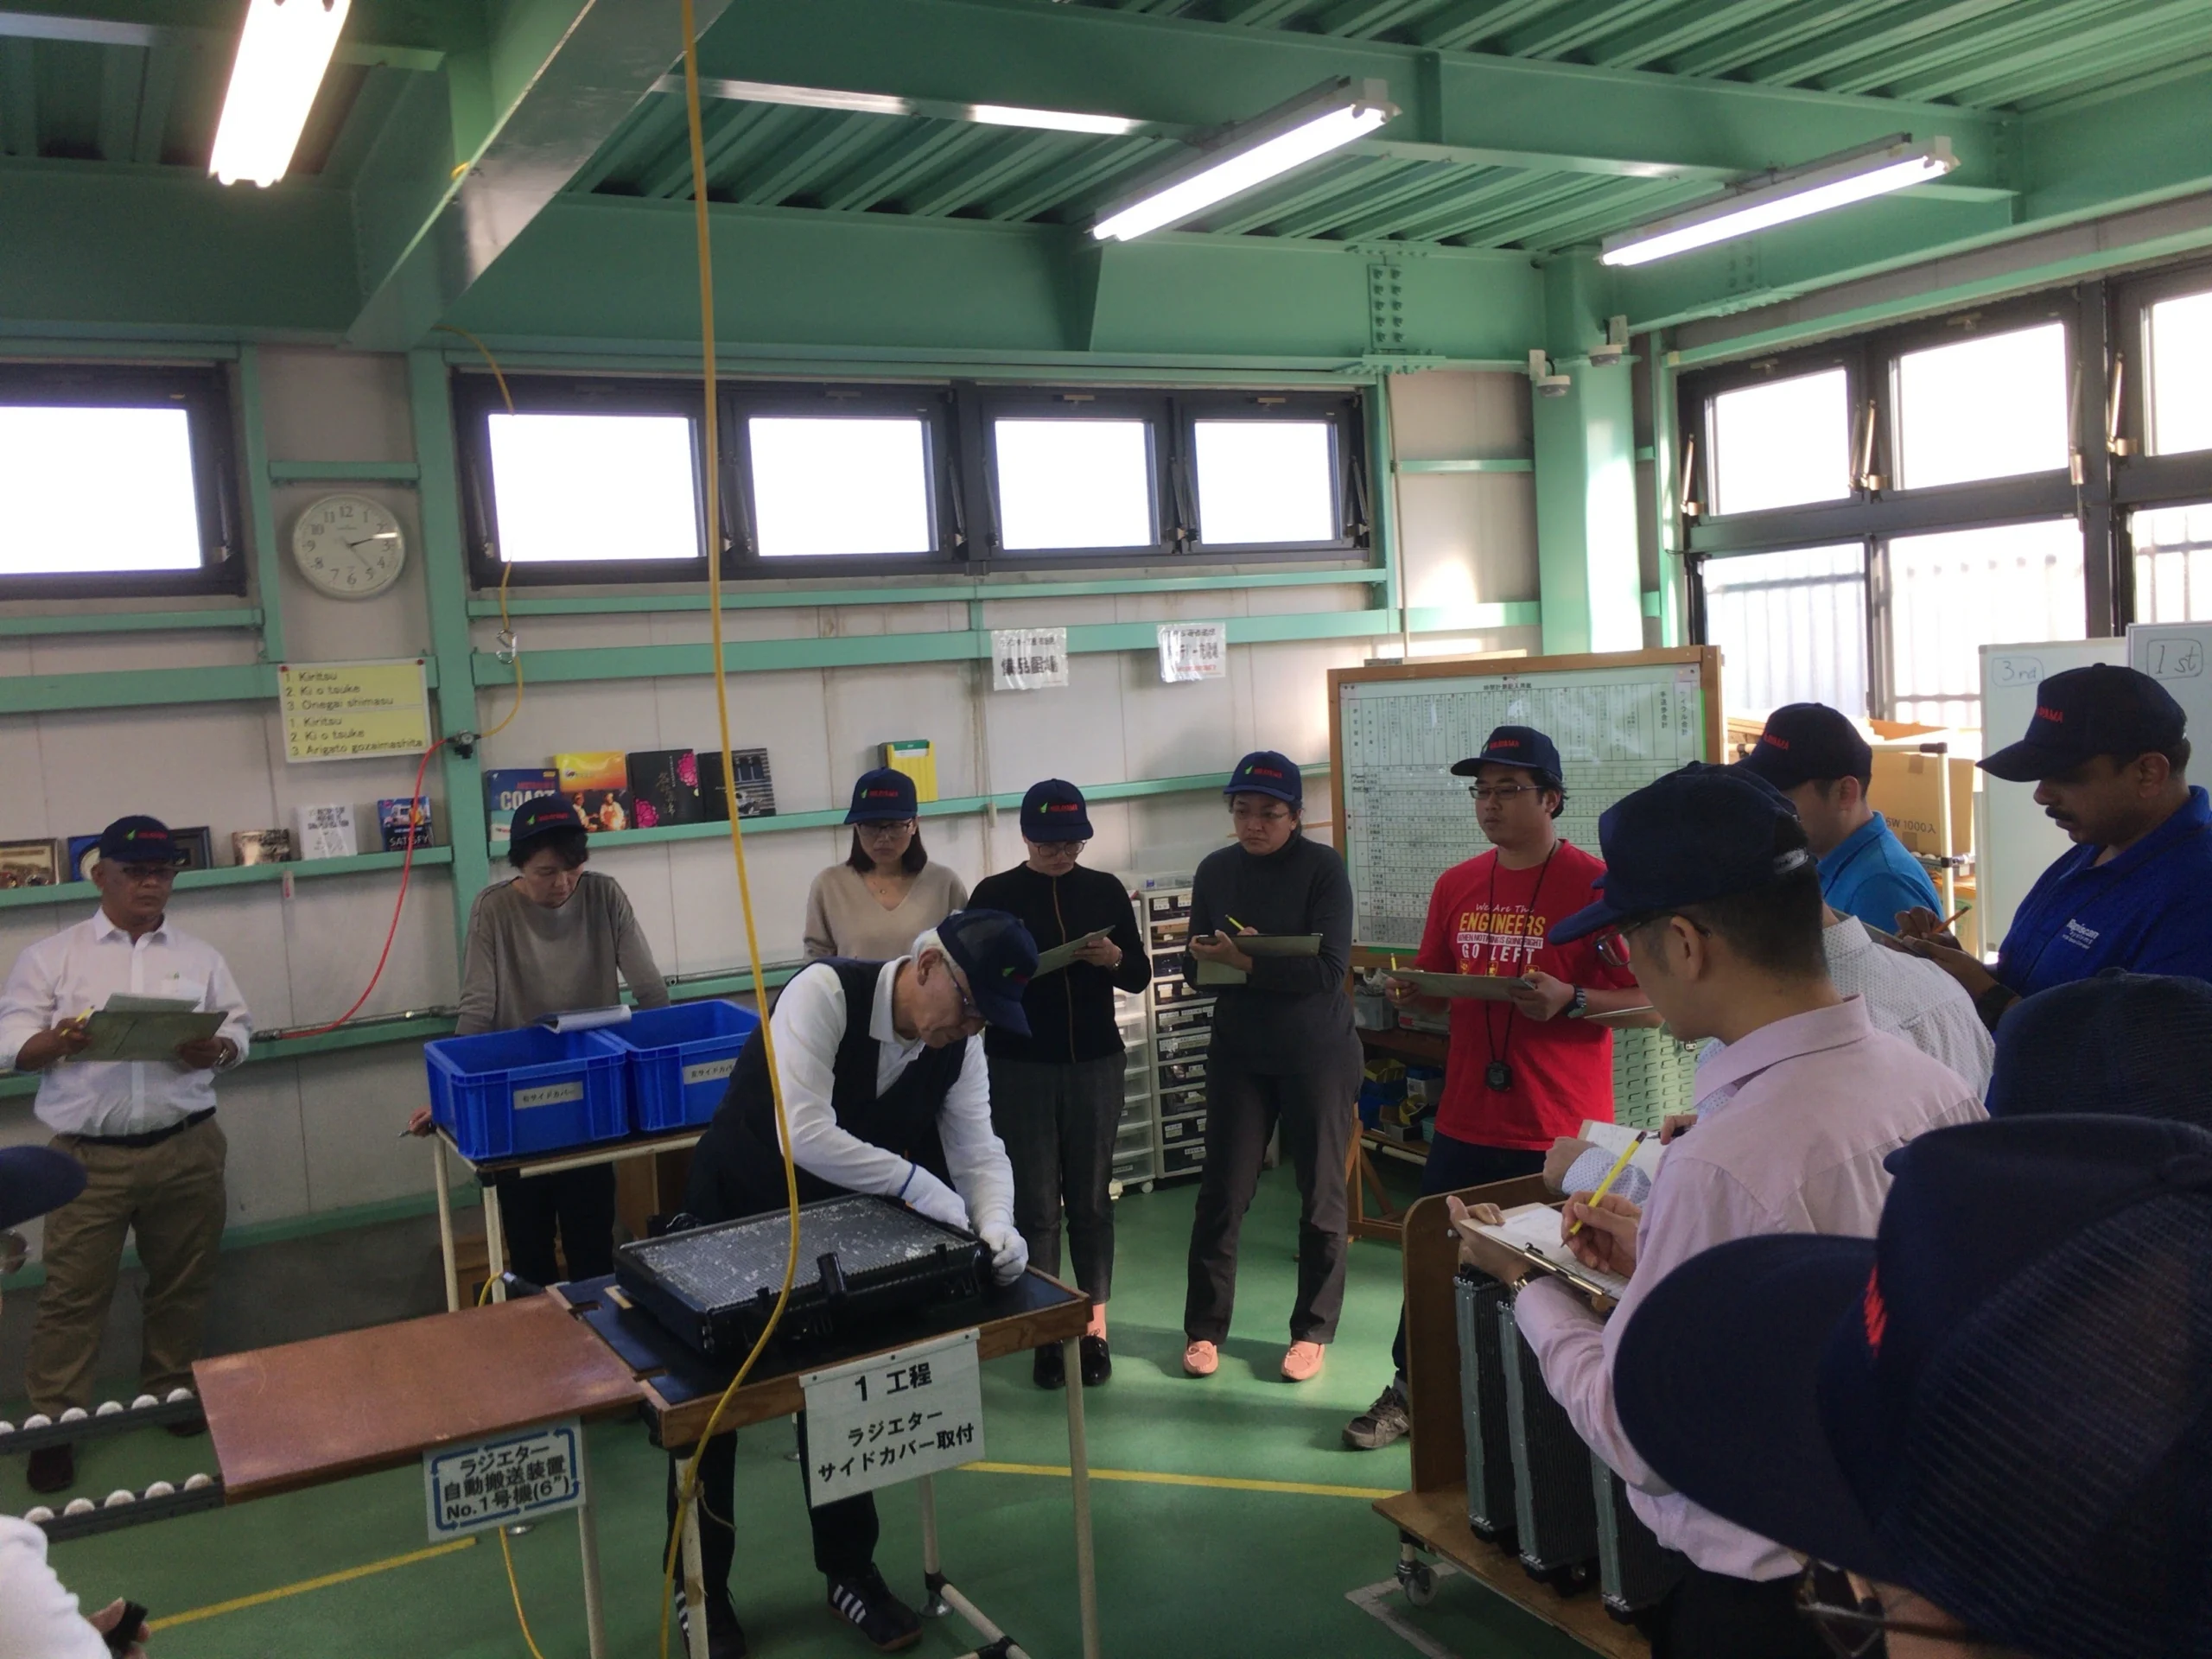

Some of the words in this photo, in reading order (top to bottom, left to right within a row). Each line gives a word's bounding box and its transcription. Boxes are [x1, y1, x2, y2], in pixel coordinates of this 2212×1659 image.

[324, 511, 335, 524] 11
[340, 505, 353, 518] 12
[363, 510, 369, 523] 1
[306, 539, 316, 553] 9
[382, 539, 391, 552] 3
[376, 556, 385, 569] 4
[328, 568, 340, 582] 7
[346, 573, 357, 585] 6
[365, 567, 374, 582] 5
[298, 671, 337, 682] Kiritsu
[1999, 660, 2037, 682] 3rd
[302, 699, 344, 710] Onegai
[347, 697, 394, 708] shimasu
[303, 716, 342, 727] Kiritsu
[306, 744, 347, 756] Arigato
[390, 835, 429, 847] SATSFY
[1476, 903, 1491, 912] We
[1492, 904, 1512, 913] Are
[1459, 912, 1546, 936] ENGINEERS
[1462, 943, 1480, 959] GO
[1491, 945, 1535, 964] LEFT
[854, 1375, 868, 1402] 1
[886, 1362, 933, 1395] 工程
[848, 1410, 944, 1448] ラジエター
[818, 1422, 975, 1483] サイドカバー取付
[460, 1445, 550, 1478] ラジエター
[444, 1455, 566, 1503] 自動搬送装置
